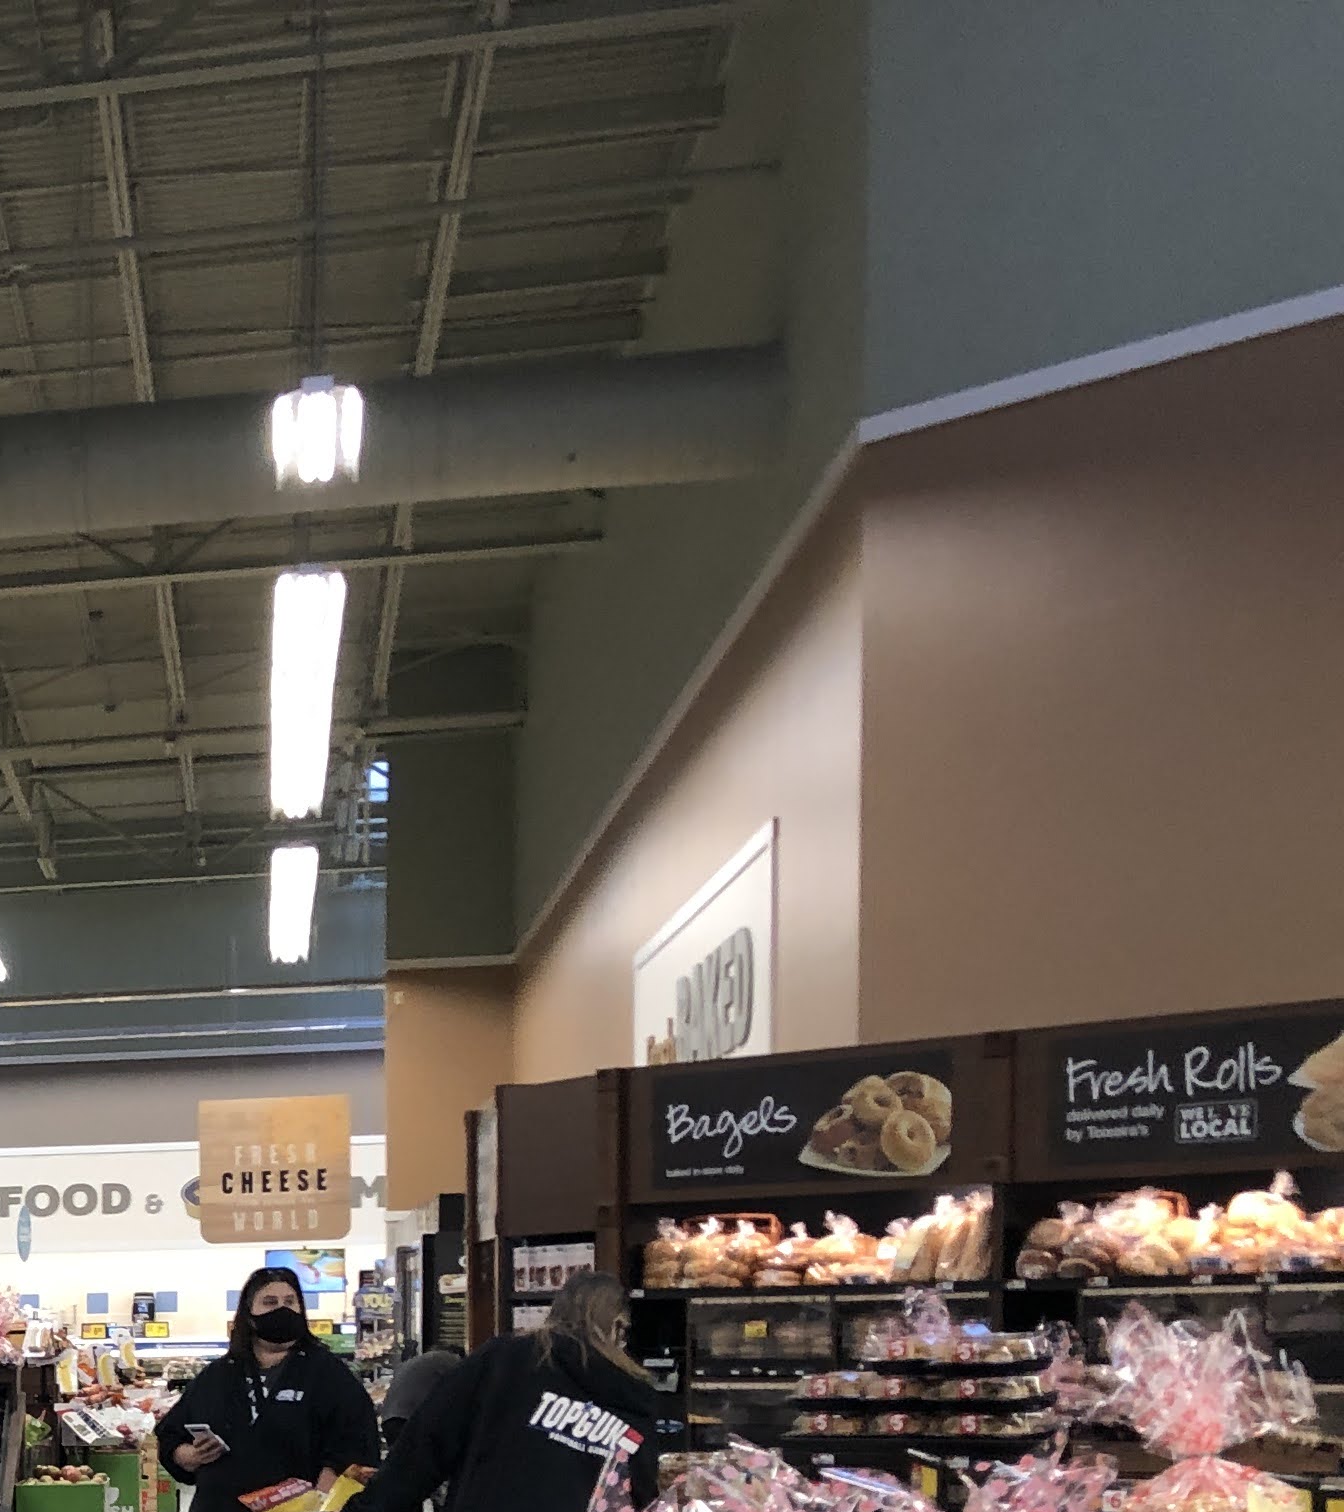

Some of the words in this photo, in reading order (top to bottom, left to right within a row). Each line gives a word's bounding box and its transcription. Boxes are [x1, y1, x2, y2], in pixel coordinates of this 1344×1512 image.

[1066, 1049, 1174, 1103] Fresh
[1185, 1041, 1283, 1096] Rolls
[665, 1096, 797, 1158] Bagels
[1066, 1127, 1083, 1143] by
[1180, 1118, 1252, 1139] LOCAL
[222, 1168, 328, 1194] CHEESE
[145, 1193, 164, 1214] &
[233, 1209, 319, 1231] WORLD
